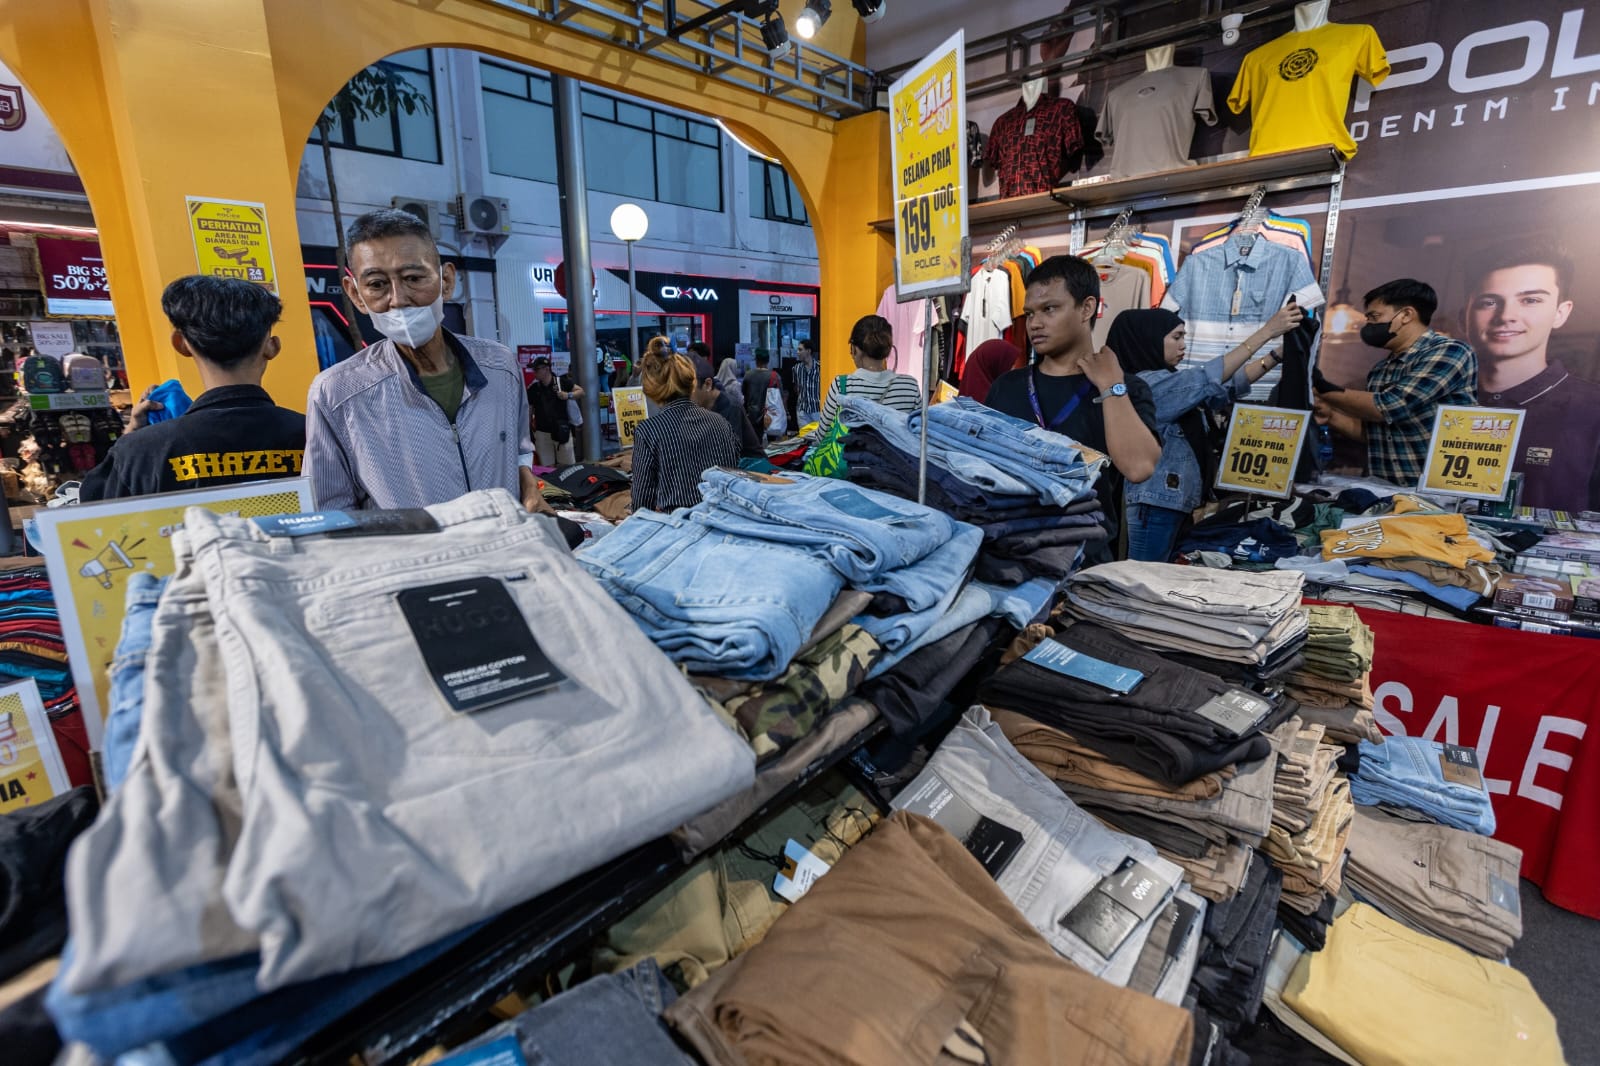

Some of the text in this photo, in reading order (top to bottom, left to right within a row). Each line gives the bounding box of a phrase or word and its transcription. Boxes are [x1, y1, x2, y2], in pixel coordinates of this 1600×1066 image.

[1351, 97, 1509, 142] DENIM
[903, 146, 951, 187] CELANA PRIA
[200, 219, 261, 233] PERHATIAN
[205, 236, 261, 247] DIAWASI OLEH
[215, 231, 250, 241] AREA INI
[914, 255, 941, 270] POLICE
[66, 264, 107, 278] BIG SA
[213, 267, 245, 280] CCTV
[248, 267, 263, 277] 24
[533, 267, 556, 283] VA
[52, 274, 111, 292] 50%+2
[660, 285, 719, 300] OXVA
[1262, 418, 1299, 431] SALE
[1470, 418, 1513, 431] SALE
[1240, 437, 1286, 452] KAUS PRIA
[1441, 439, 1503, 453] UNDERWEAR
[1231, 450, 1270, 478] 109.
[1441, 454, 1501, 480] 79. 000.
[1445, 479, 1479, 488] POLICE
[277, 514, 325, 526] HUGO
[443, 655, 527, 682] PREMIUM COTTON
[1373, 681, 1588, 811] SALE
